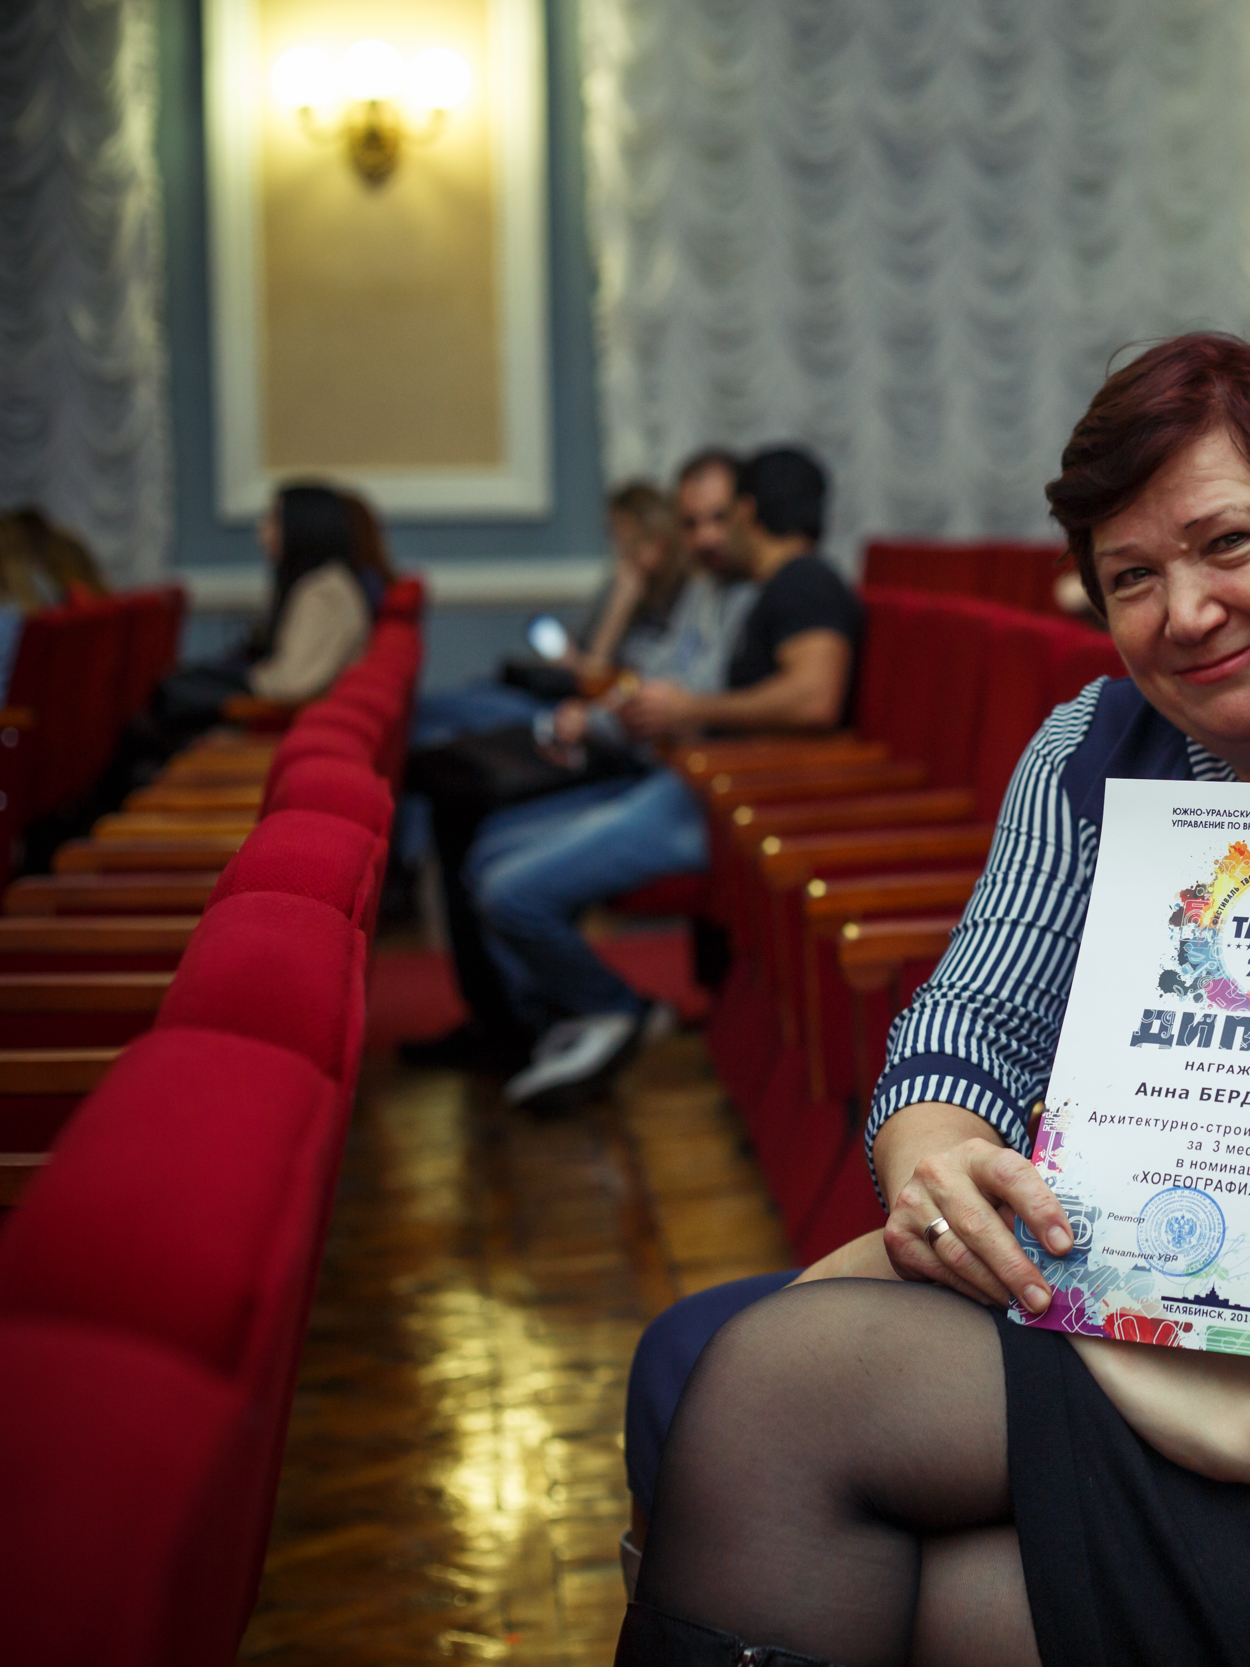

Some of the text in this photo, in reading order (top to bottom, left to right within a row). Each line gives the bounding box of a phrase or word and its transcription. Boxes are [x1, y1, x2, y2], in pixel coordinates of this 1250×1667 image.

[1172, 820, 1225, 829] УПРАВЛЕНИЕ
[1227, 822, 1240, 830] ПО
[1212, 886, 1240, 925] ФЕСТИВАЛЬ
[1135, 1082, 1190, 1100] Анна
[1187, 1140, 1202, 1150] за
[1213, 1140, 1220, 1152] 3
[1176, 1158, 1184, 1168] в
[1107, 1212, 1145, 1225] Ректор
[1102, 1246, 1178, 1262] Начальник УВР
[1162, 1303, 1226, 1321] ЧЕЛЯБИНСК,
